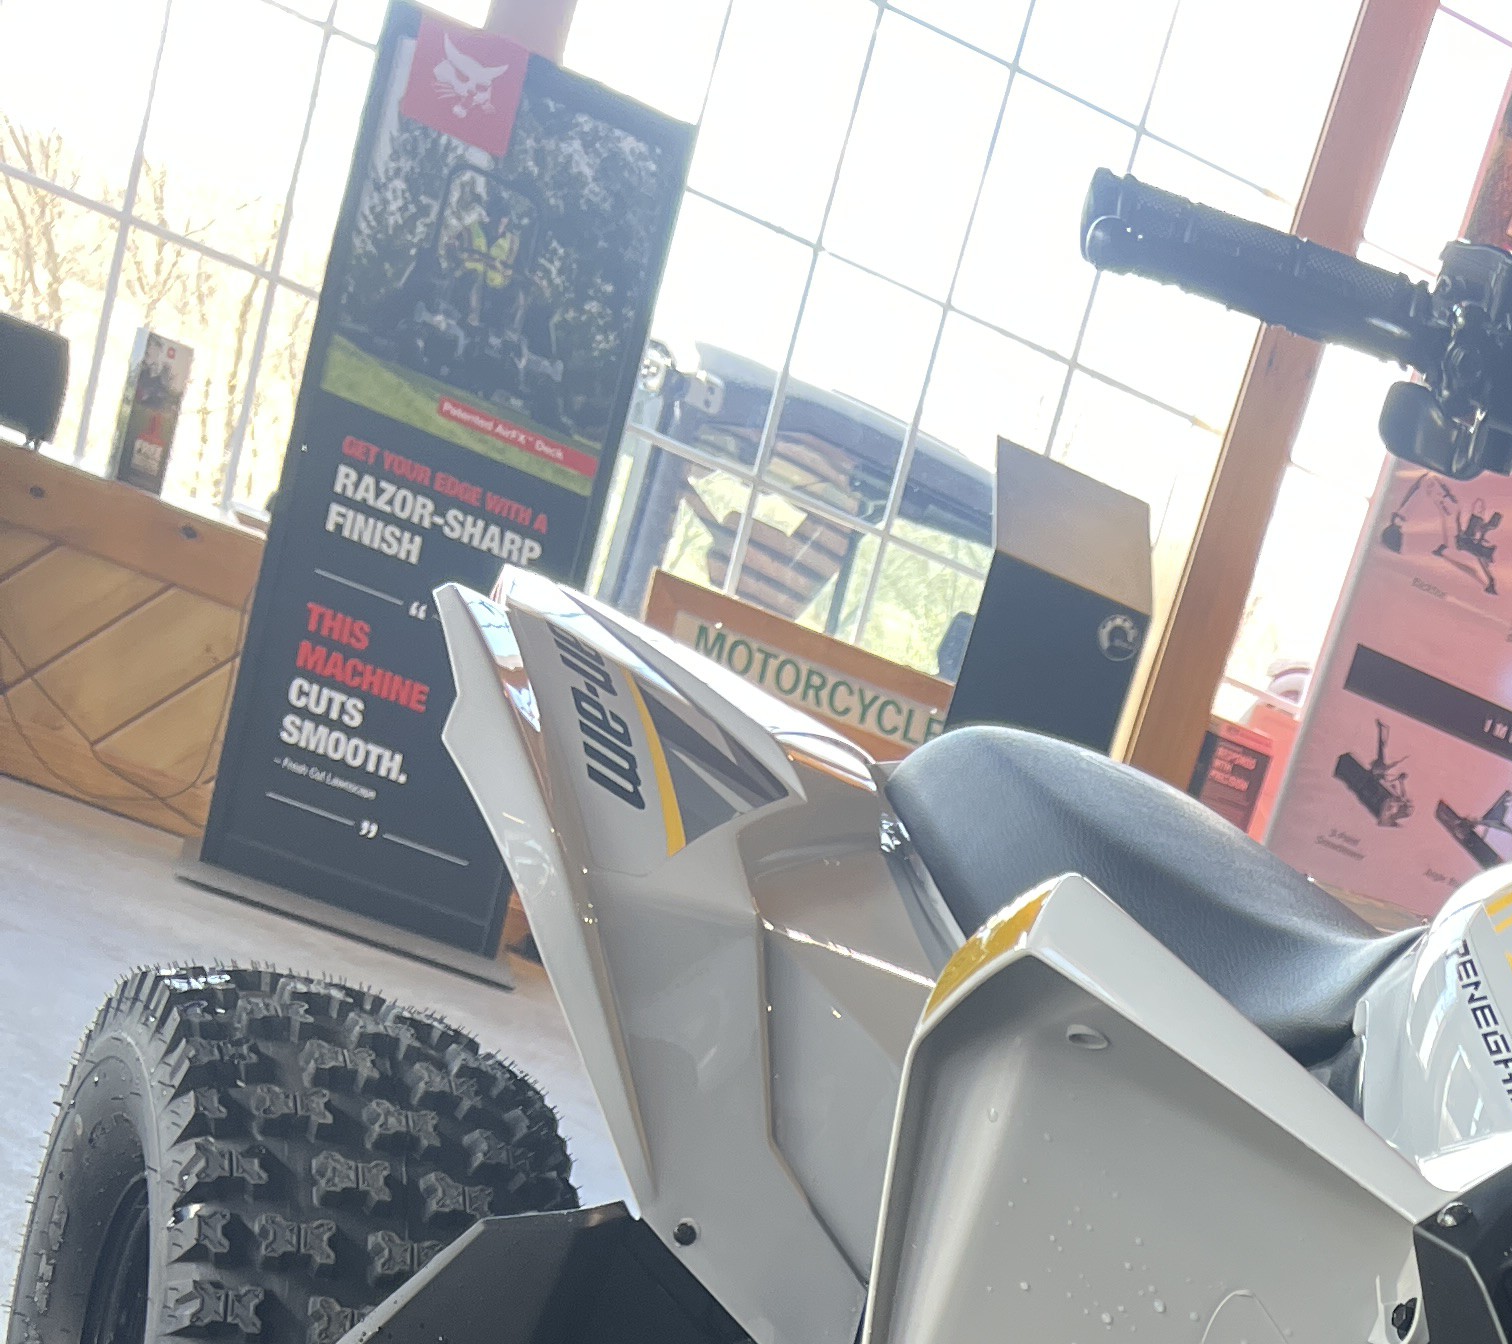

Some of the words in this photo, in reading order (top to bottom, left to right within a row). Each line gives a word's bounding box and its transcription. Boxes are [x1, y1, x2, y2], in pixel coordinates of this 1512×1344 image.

[442, 401, 493, 431] Patented
[535, 440, 564, 460] Deck
[333, 464, 543, 565] RAZOR-SHARP
[342, 435, 380, 465] GET
[383, 451, 432, 487] YOUR
[434, 472, 483, 507] EDGE
[485, 492, 531, 526] WITH
[533, 513, 548, 535] A
[325, 502, 423, 565] FINISH
[306, 602, 371, 650] THIS
[288, 677, 365, 728] CUTS
[296, 640, 430, 713] MACHINE
[280, 713, 408, 785] SMOOTH.
[546, 620, 645, 810] an-am
